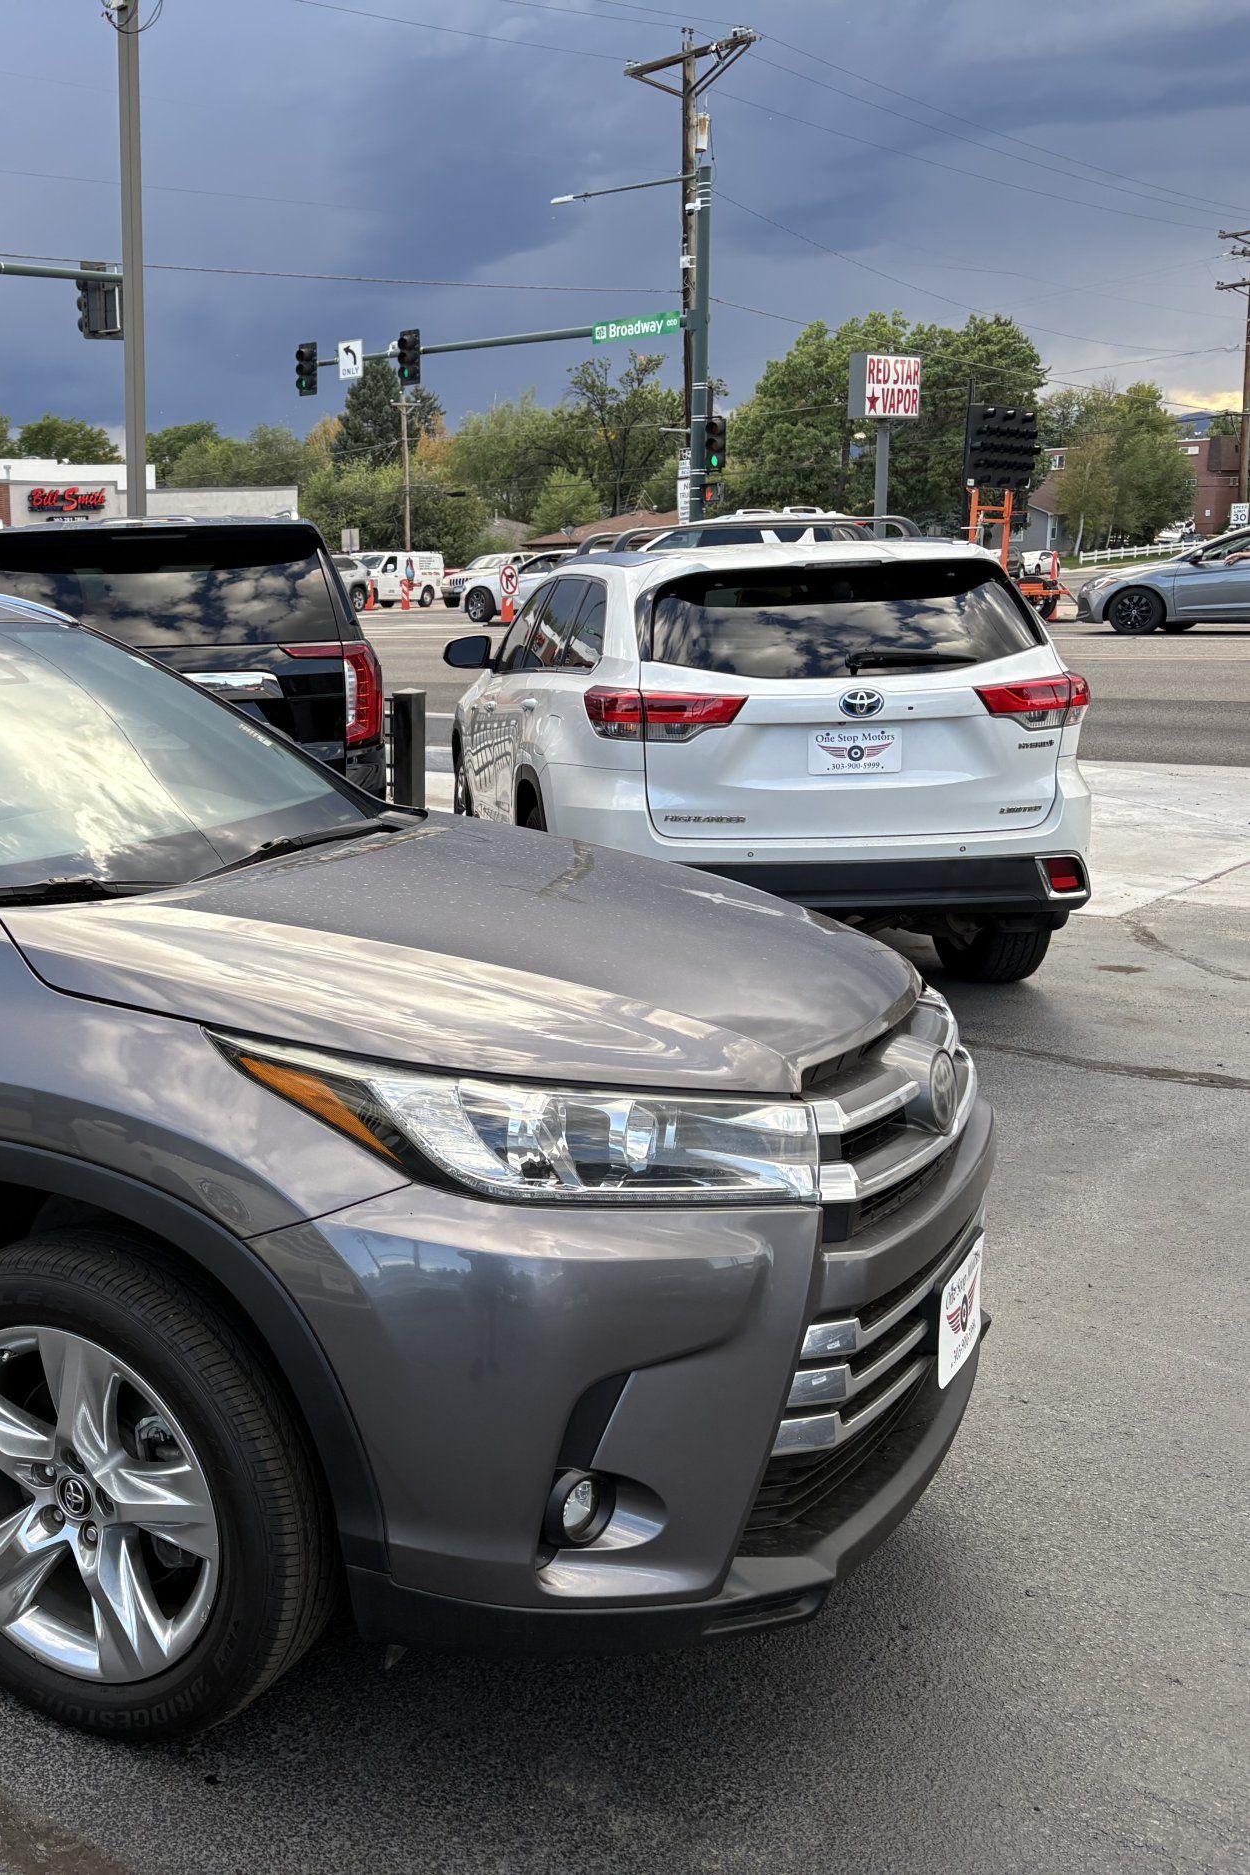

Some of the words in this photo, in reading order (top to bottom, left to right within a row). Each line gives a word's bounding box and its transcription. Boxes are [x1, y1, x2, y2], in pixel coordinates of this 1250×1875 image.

[609, 320, 663, 338] Broadway
[342, 367, 359, 376] ONLY
[868, 358, 891, 384] RED
[893, 359, 920, 385] STAR
[882, 388, 918, 414] VAPOR
[32, 488, 60, 507] Bill
[62, 487, 106, 511] Smith
[815, 734, 835, 743] One
[838, 733, 858, 743] Stop
[862, 733, 895, 741] Motors
[832, 762, 880, 770] 303-900-5999
[664, 815, 746, 823] HIGHLANDER
